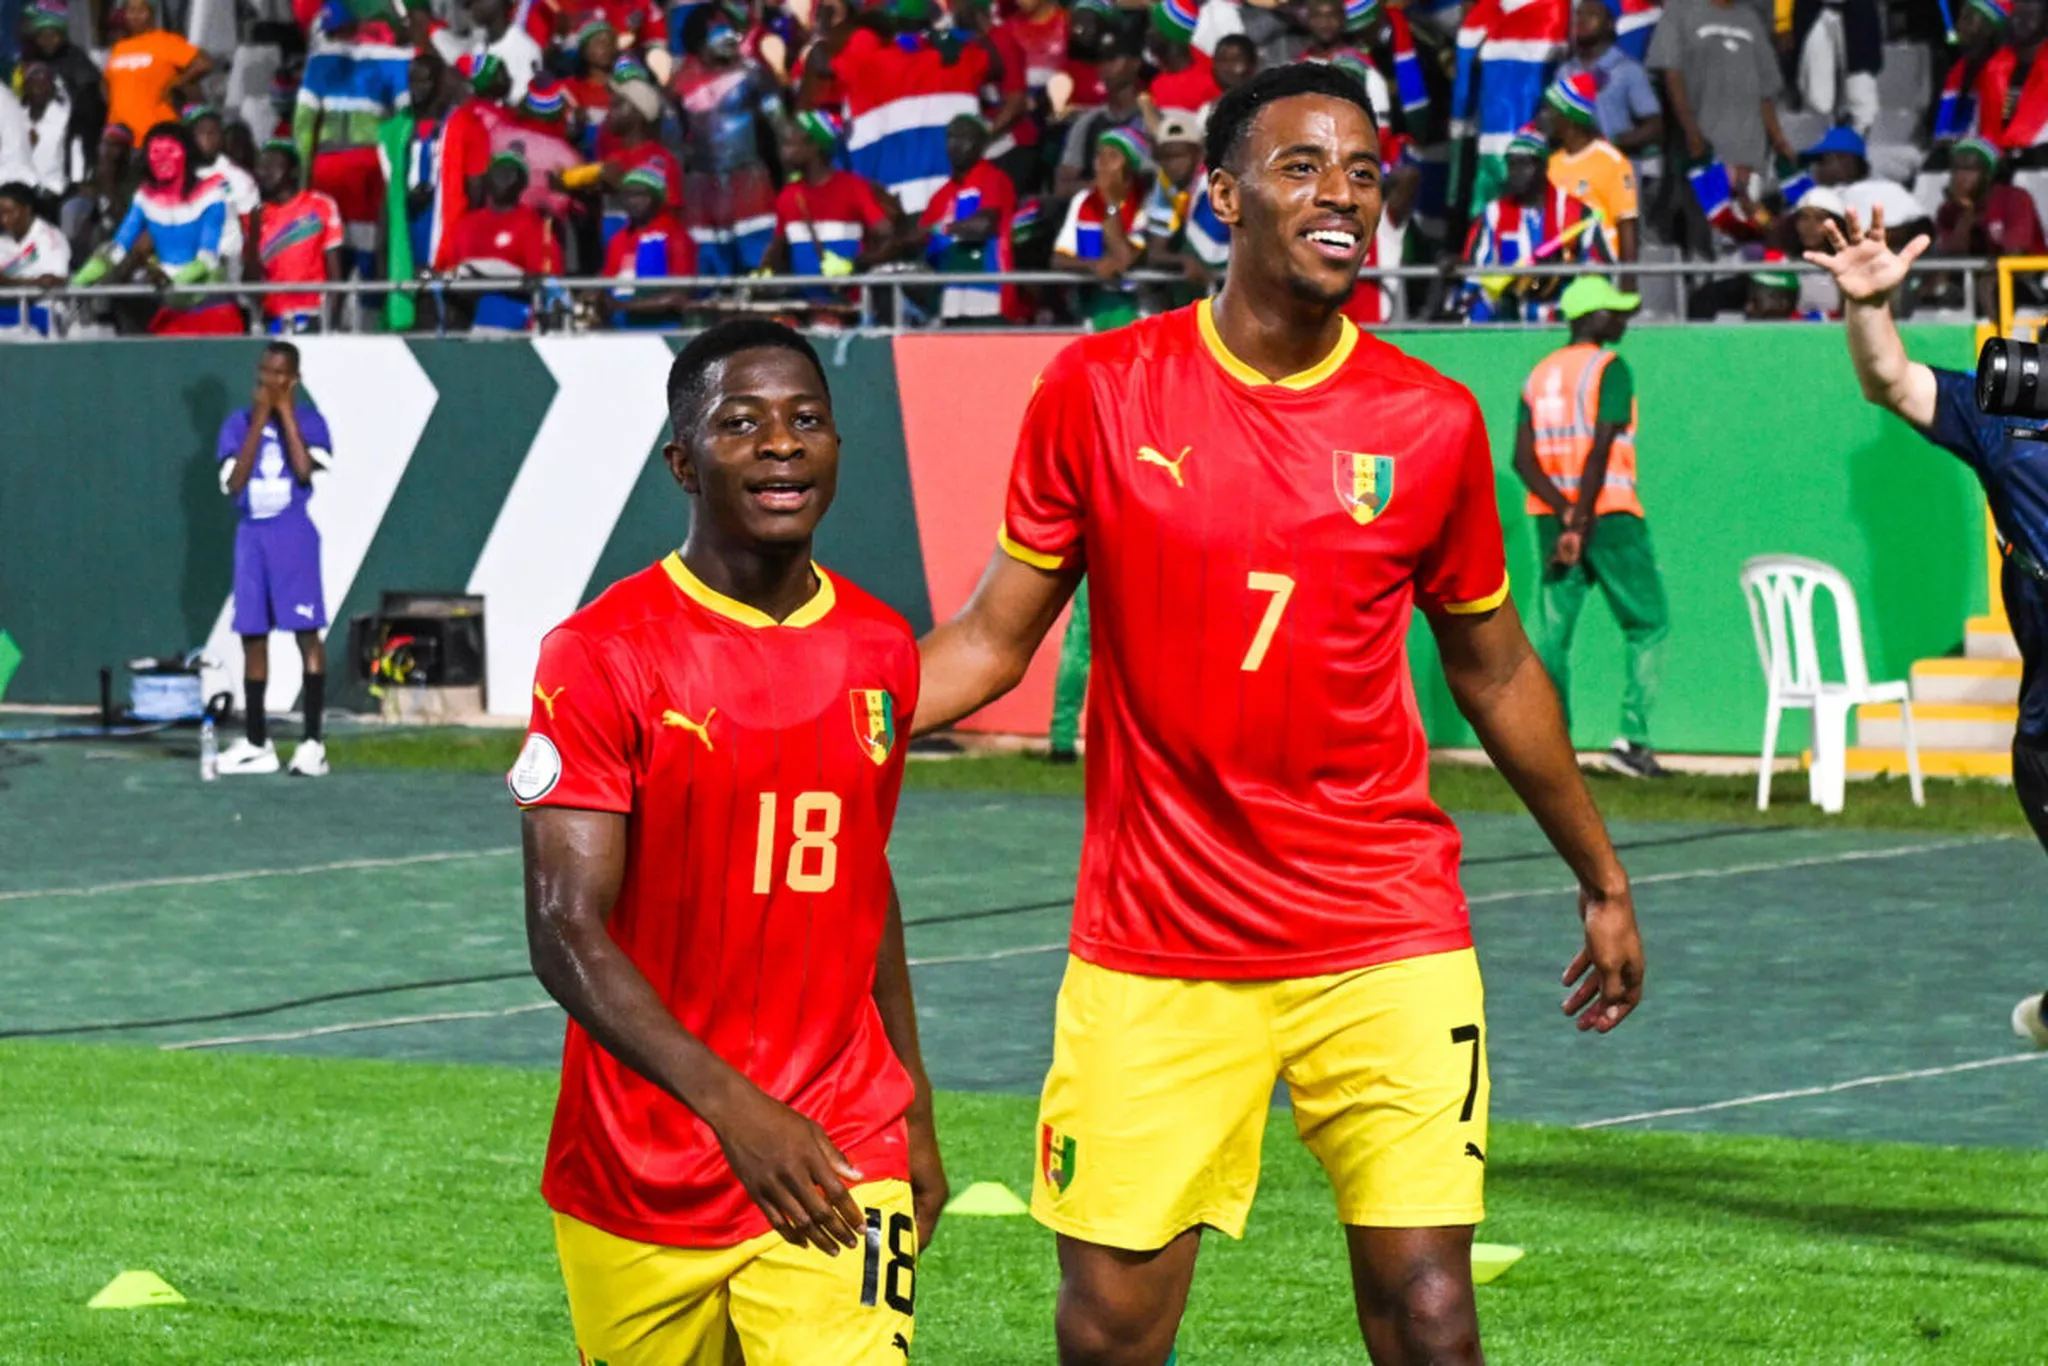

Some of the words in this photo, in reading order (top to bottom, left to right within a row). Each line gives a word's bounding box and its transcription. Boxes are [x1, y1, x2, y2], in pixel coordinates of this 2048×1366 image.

[1240, 571, 1296, 671] 7
[753, 791, 842, 894] 18
[1451, 1024, 1479, 1122] 7
[860, 1207, 915, 1317] 18
